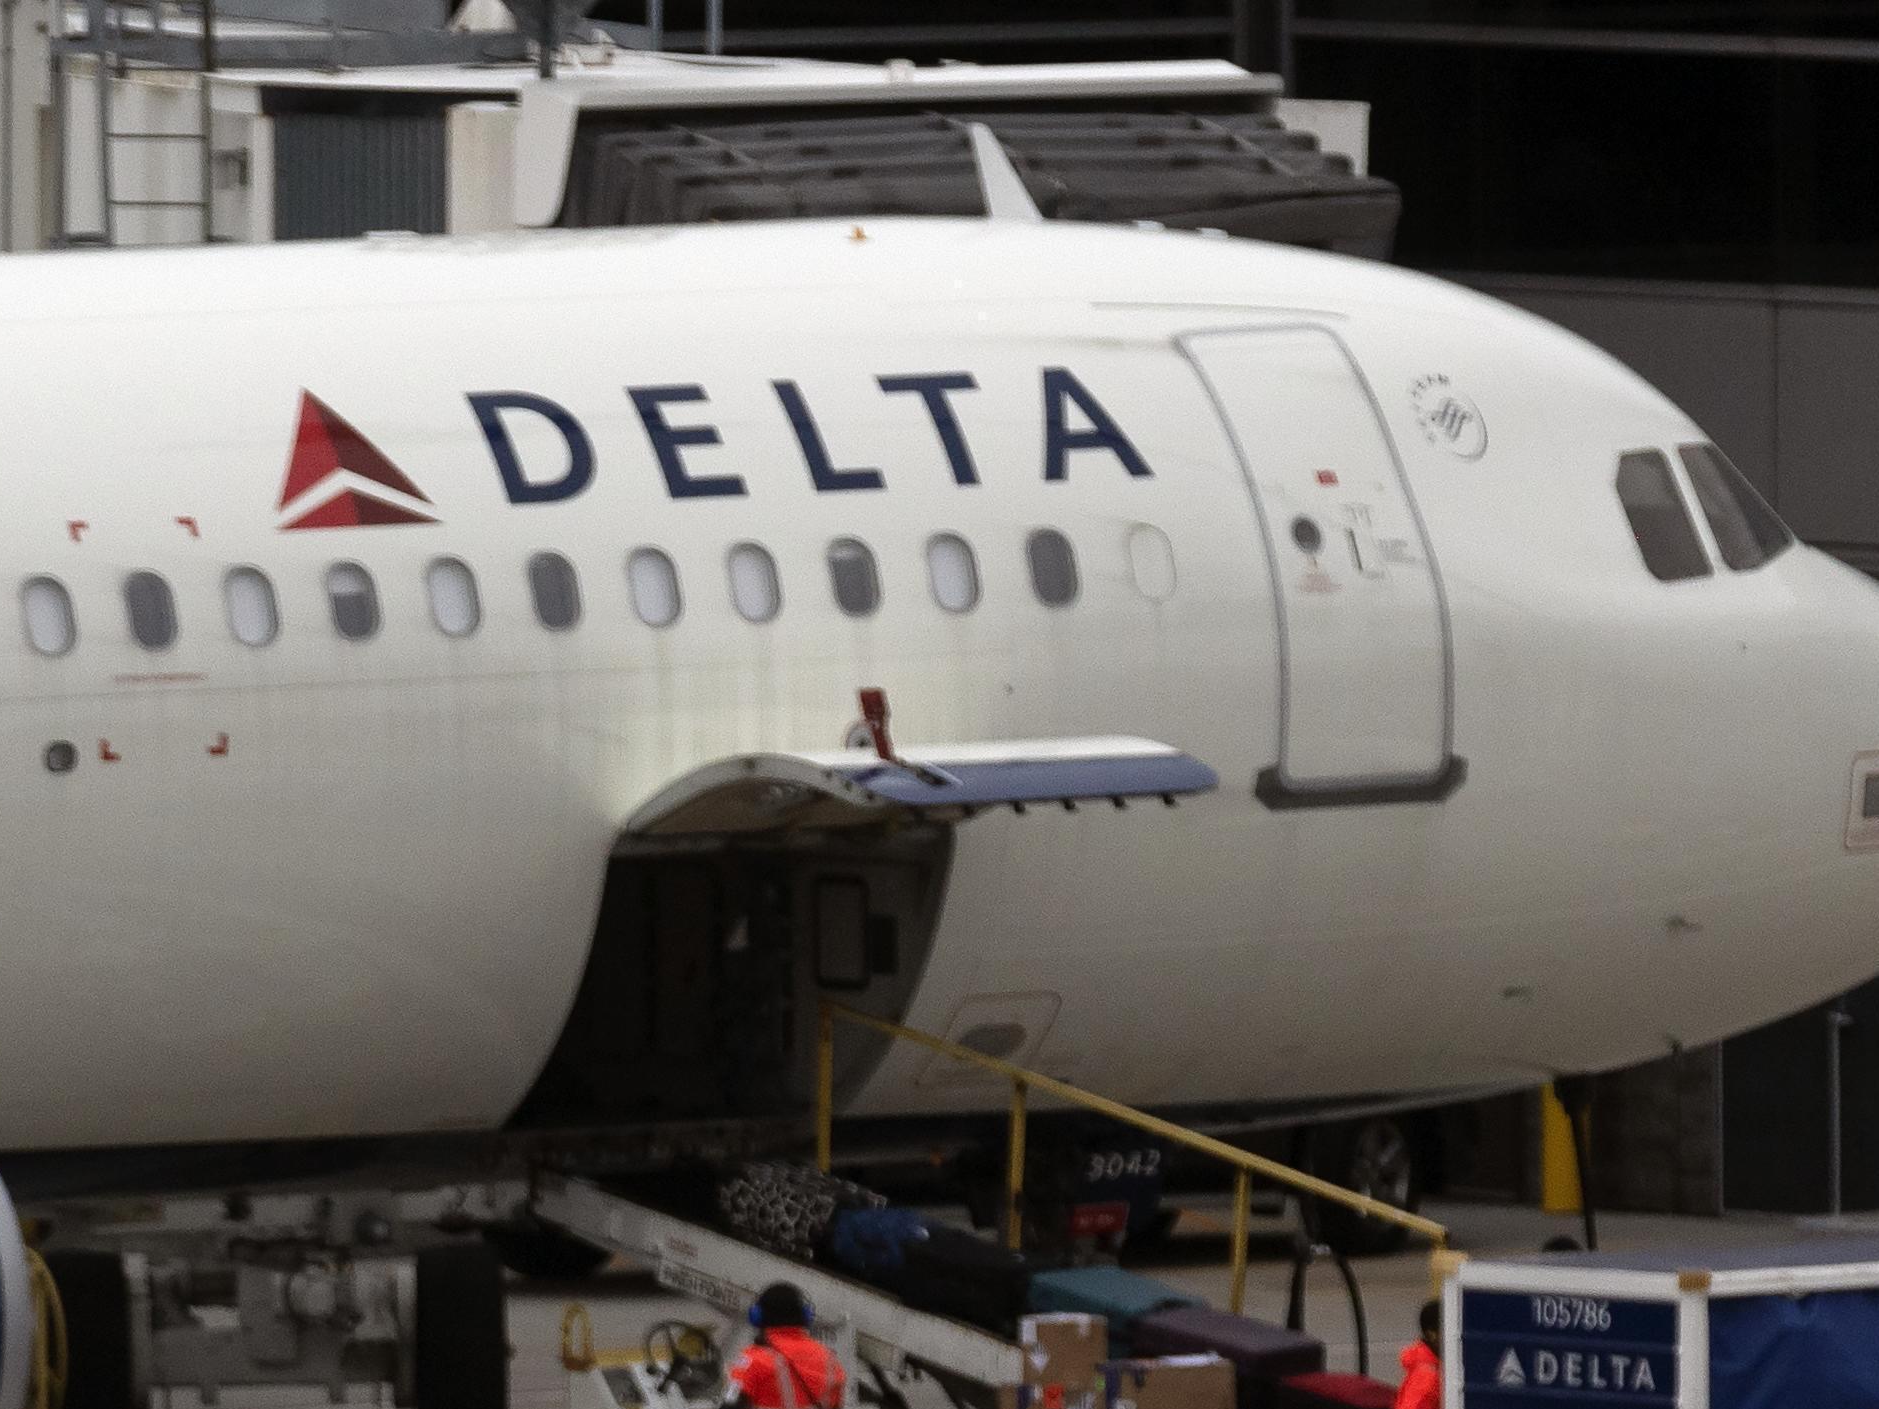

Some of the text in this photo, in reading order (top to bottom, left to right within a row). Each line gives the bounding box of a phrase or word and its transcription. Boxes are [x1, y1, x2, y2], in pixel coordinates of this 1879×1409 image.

[465, 367, 1154, 507] DELTA
[1531, 1297, 1613, 1332] 105786
[1534, 1350, 1656, 1391] DELTA
